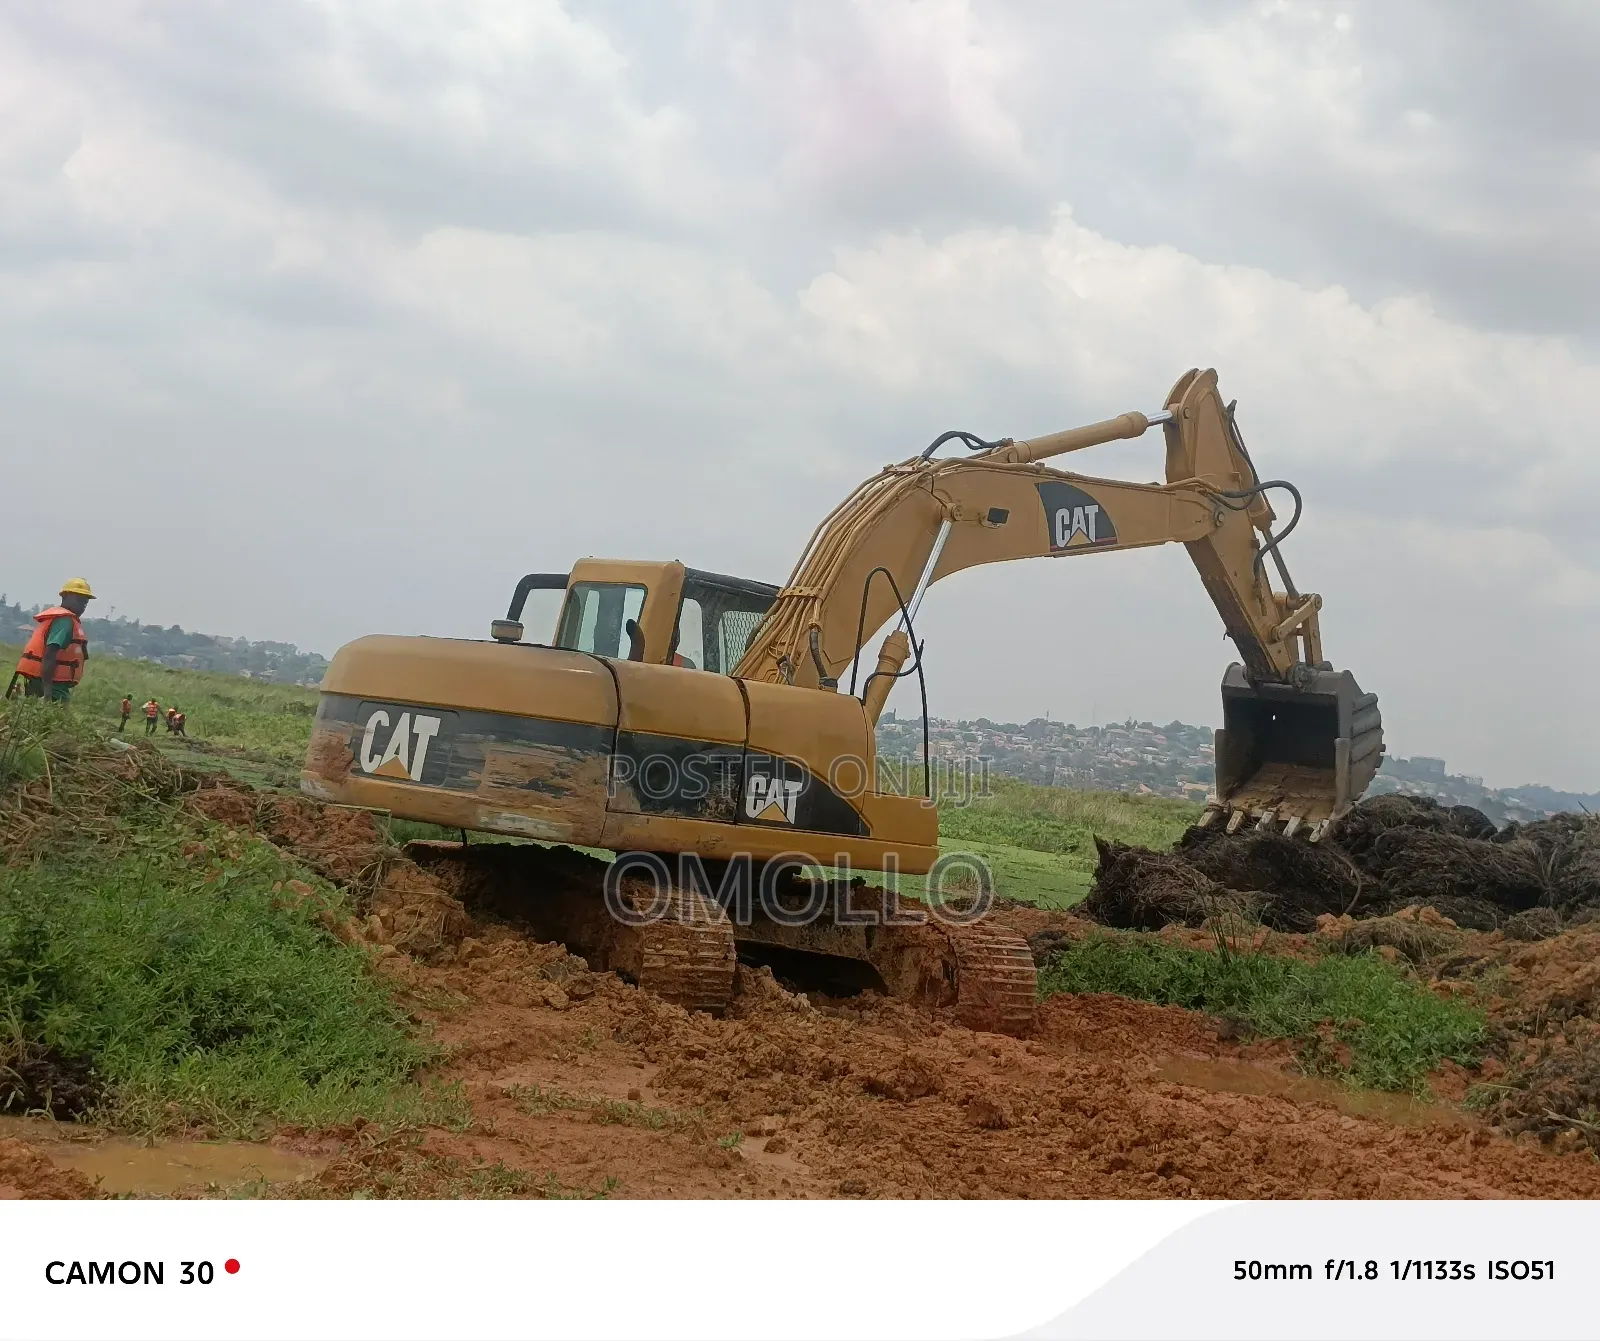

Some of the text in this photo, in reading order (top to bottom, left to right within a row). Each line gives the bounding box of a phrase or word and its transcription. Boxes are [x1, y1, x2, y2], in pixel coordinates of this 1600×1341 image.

[1055, 504, 1099, 547] CAT
[359, 709, 441, 782] CAT
[746, 773, 803, 825] CAT
